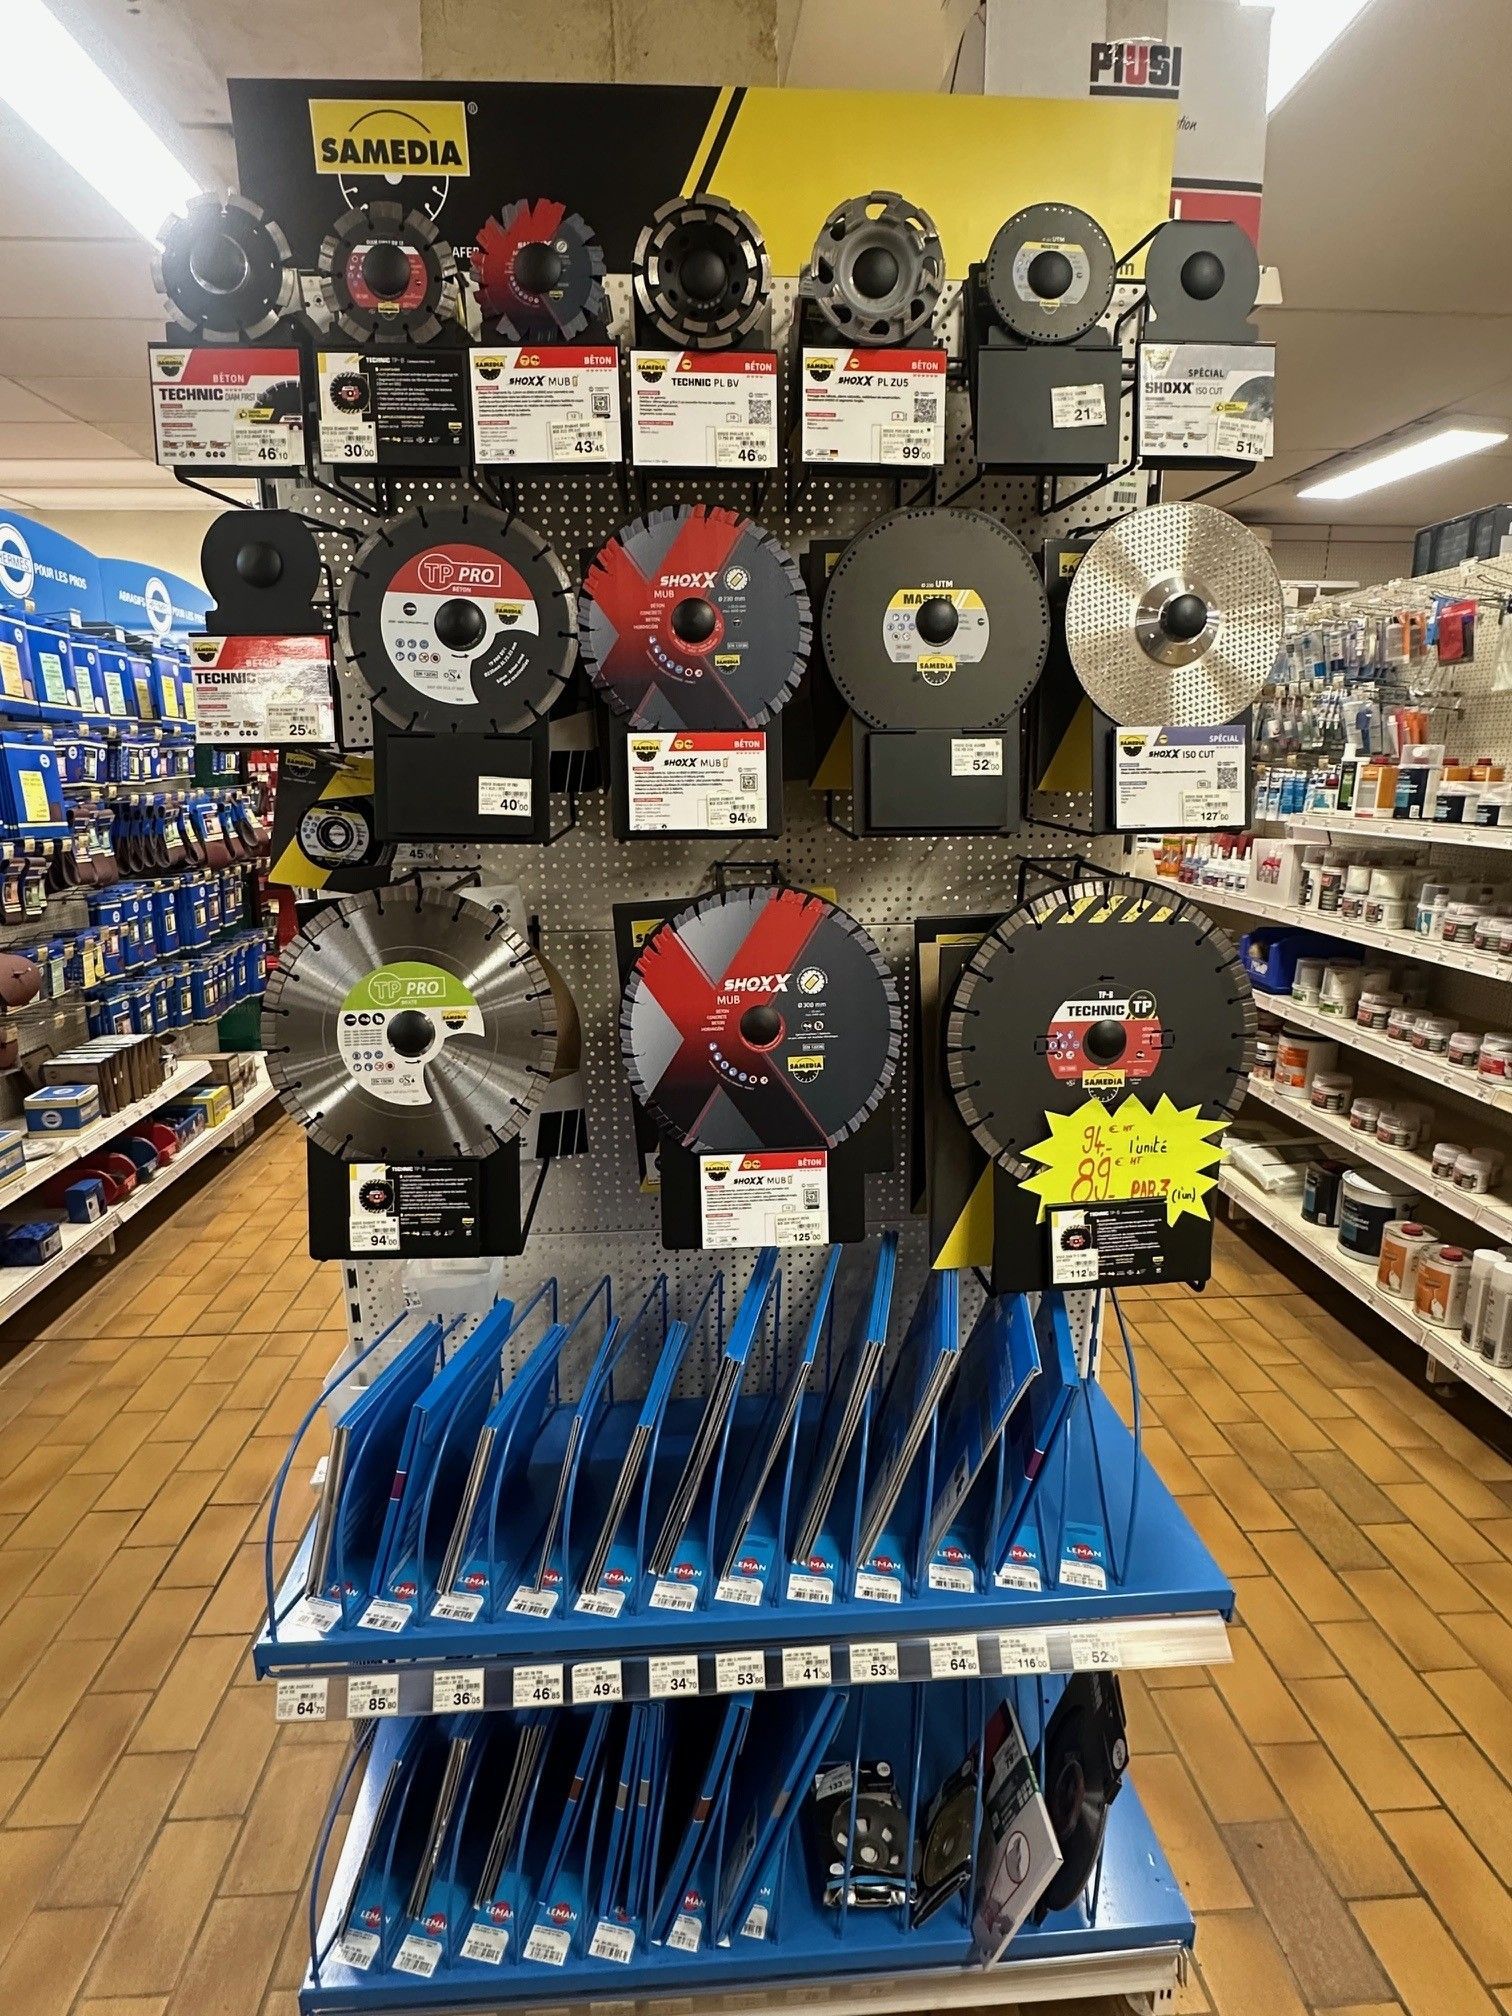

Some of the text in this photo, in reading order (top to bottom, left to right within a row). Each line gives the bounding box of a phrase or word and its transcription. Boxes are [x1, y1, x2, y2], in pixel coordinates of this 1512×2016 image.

[1090, 42, 1182, 85] PIUSI
[320, 137, 463, 167] SAMEDIA
[584, 354, 612, 365] BÉTON
[911, 360, 938, 370] BÉTON
[744, 361, 772, 372] BÉTON
[213, 372, 245, 383] BÉTON
[1188, 368, 1224, 378] SPÉCIAL
[509, 375, 571, 386] SHOXX MUB
[671, 377, 740, 388] TECHNIC PL BV
[837, 375, 875, 387] SHOXX
[877, 379, 888, 387] PL
[159, 388, 223, 401] TECHNIC
[1145, 382, 1193, 396] SHOXX
[33, 562, 88, 590] POUR LES PROS
[424, 562, 495, 584] TP PRO
[660, 571, 718, 588] SHOXX
[935, 580, 953, 588] UTM
[654, 590, 675, 598] MUB
[195, 672, 257, 684] TECHNIC
[734, 739, 760, 748] BÉTON
[1209, 733, 1239, 743] SPÉCIAL
[1148, 749, 1215, 758] SHOXX ISO CUT
[664, 757, 722, 768] SHOXX MUB
[724, 973, 792, 993] SHOXX
[374, 981, 439, 999] TP PRO
[716, 996, 740, 1005] MUB
[1067, 1000, 1152, 1017] TECHNIC TP
[1084, 1078, 1123, 1086] SAMEDIA
[1129, 1135, 1168, 1154] l'unité
[797, 1157, 822, 1167] BÉTON
[733, 1176, 786, 1186] SHOXX MUB
[937, 1549, 971, 1561] LEMAN
[1066, 1546, 1101, 1559] LEMAN
[866, 1559, 901, 1570] LEMAN
[669, 1565, 702, 1577] LEMAN
[603, 1572, 633, 1583] EMAN
[546, 1906, 577, 1921] LEMAN
